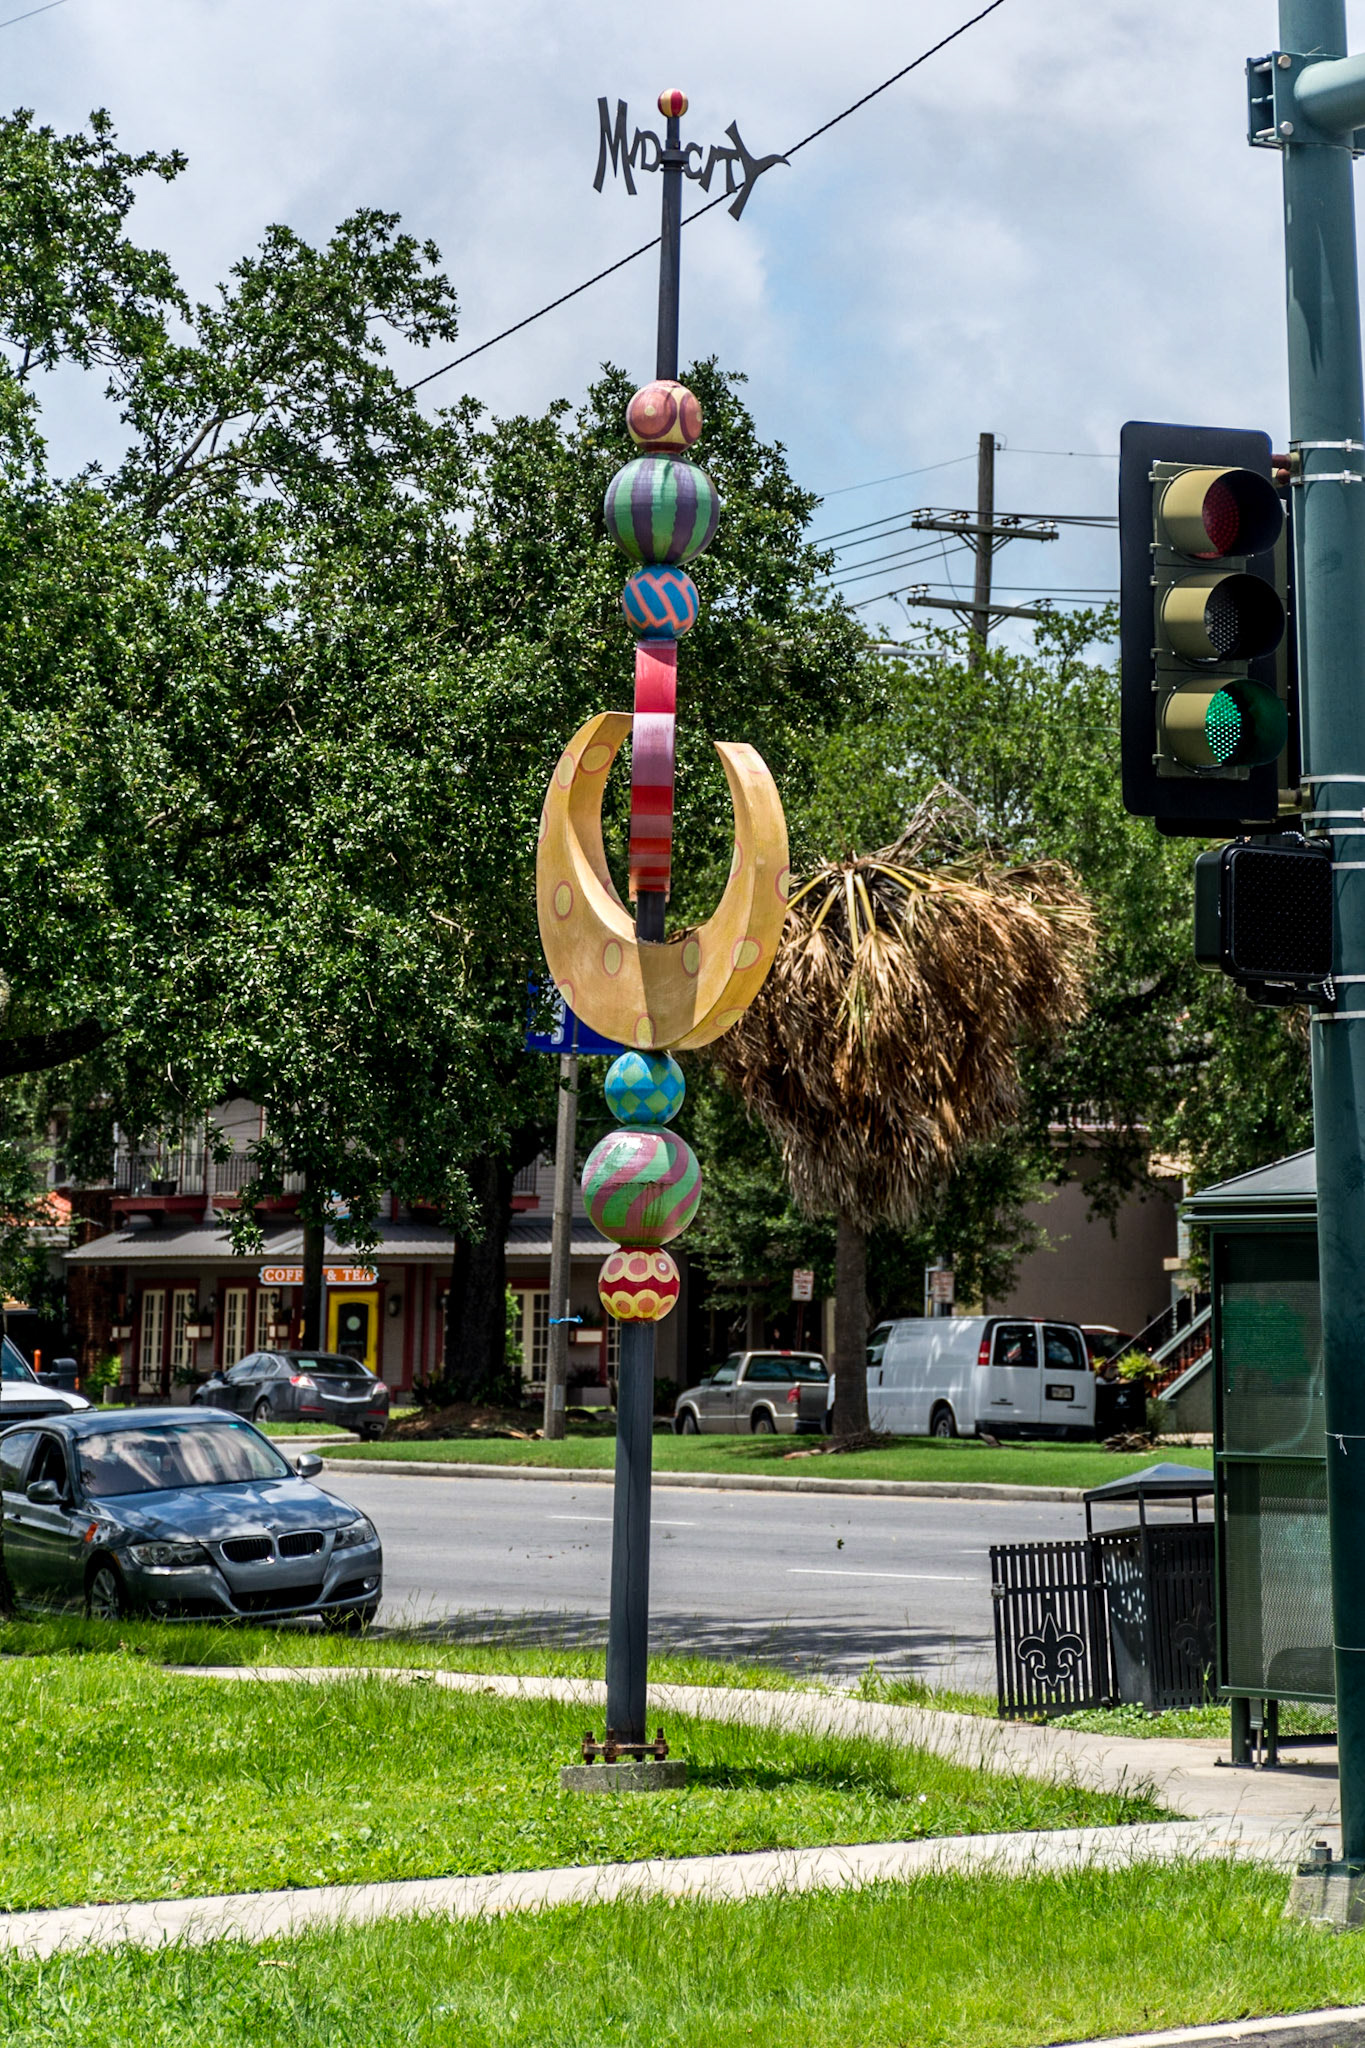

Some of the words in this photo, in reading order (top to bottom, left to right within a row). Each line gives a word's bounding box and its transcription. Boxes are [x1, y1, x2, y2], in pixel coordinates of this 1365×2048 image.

[265, 1269, 303, 1281] COFF
[327, 1269, 337, 1281] &
[342, 1269, 371, 1281] TEA
